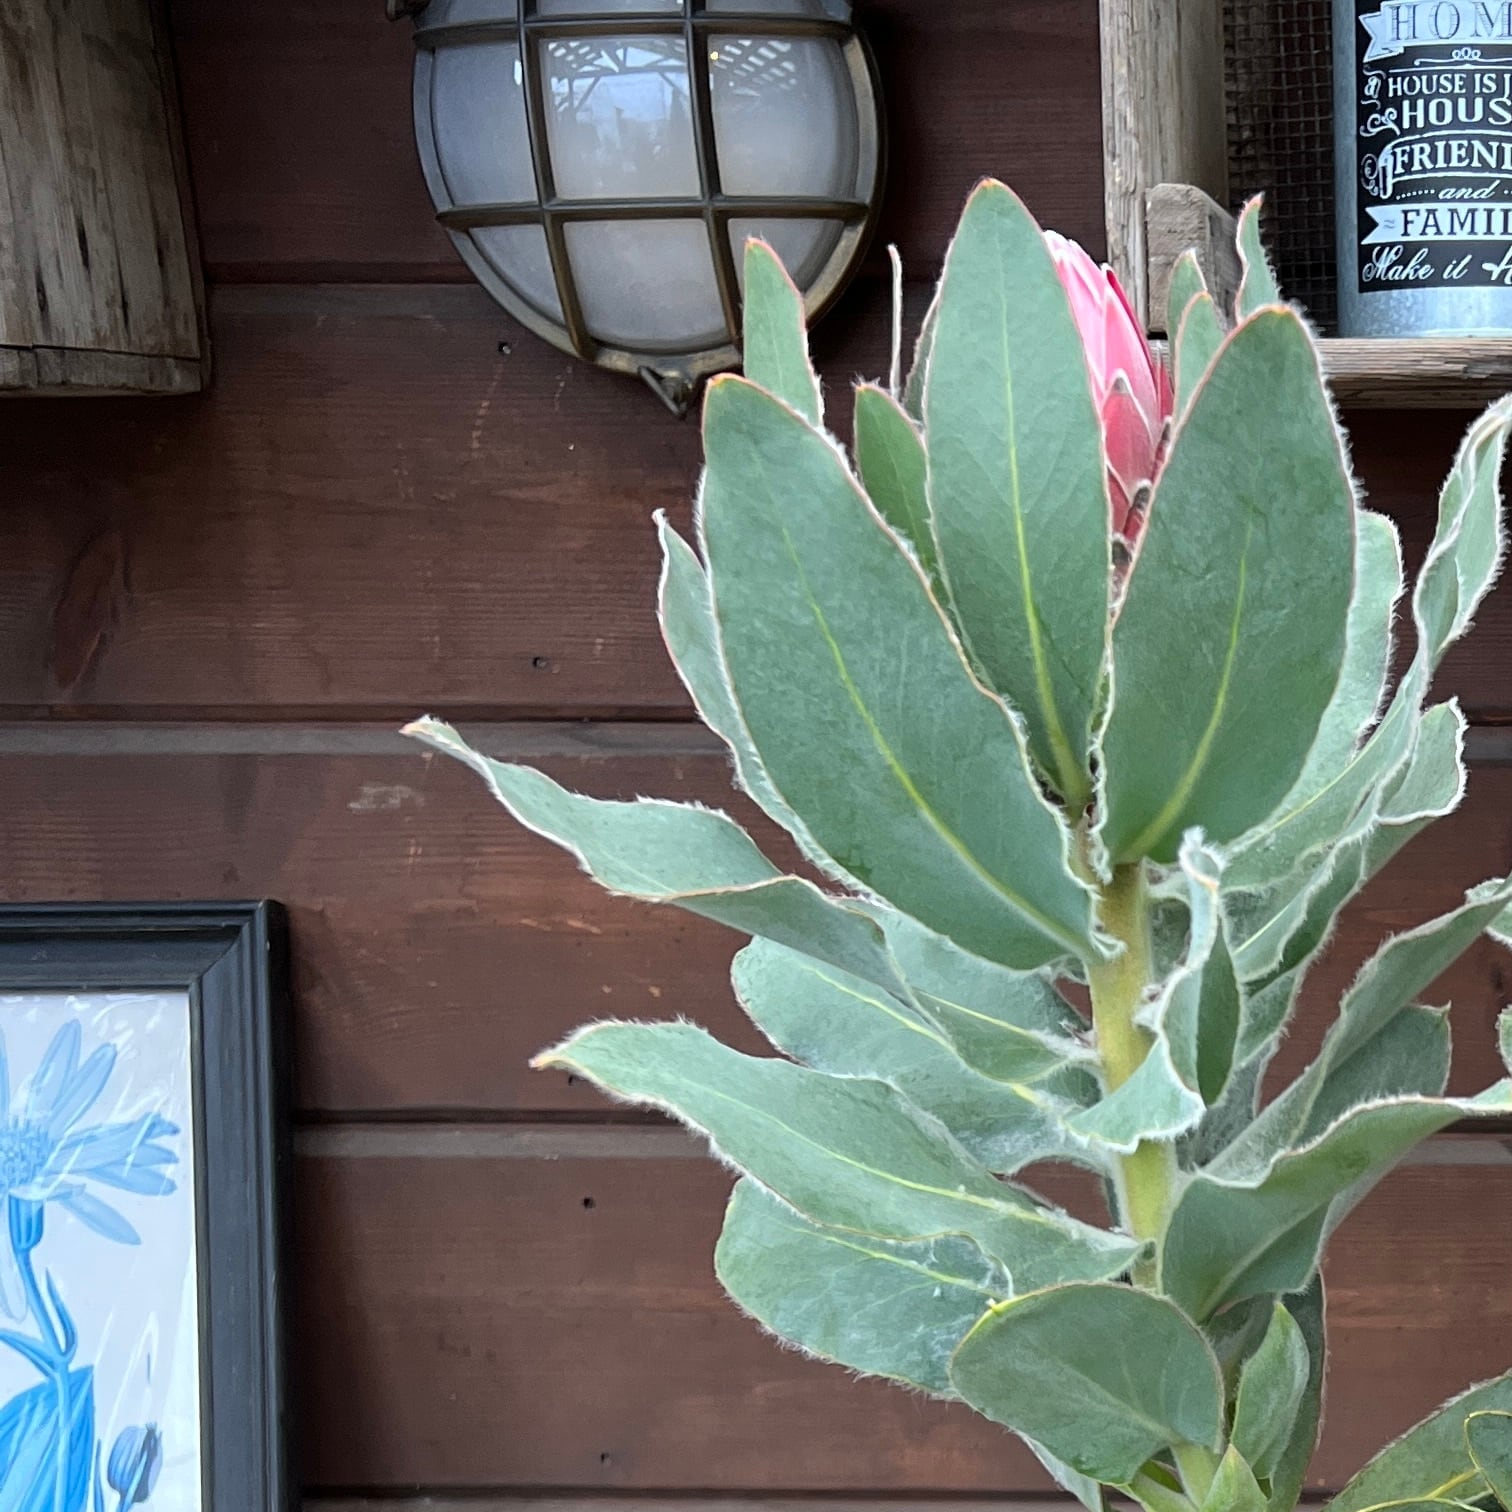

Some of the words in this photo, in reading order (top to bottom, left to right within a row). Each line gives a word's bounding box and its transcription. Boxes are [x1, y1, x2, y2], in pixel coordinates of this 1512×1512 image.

[1388, 73, 1467, 97] HOUSE
[1474, 73, 1497, 93] IS
[1439, 180, 1500, 200] and
[1362, 245, 1434, 282] Make
[1443, 255, 1473, 280] it
